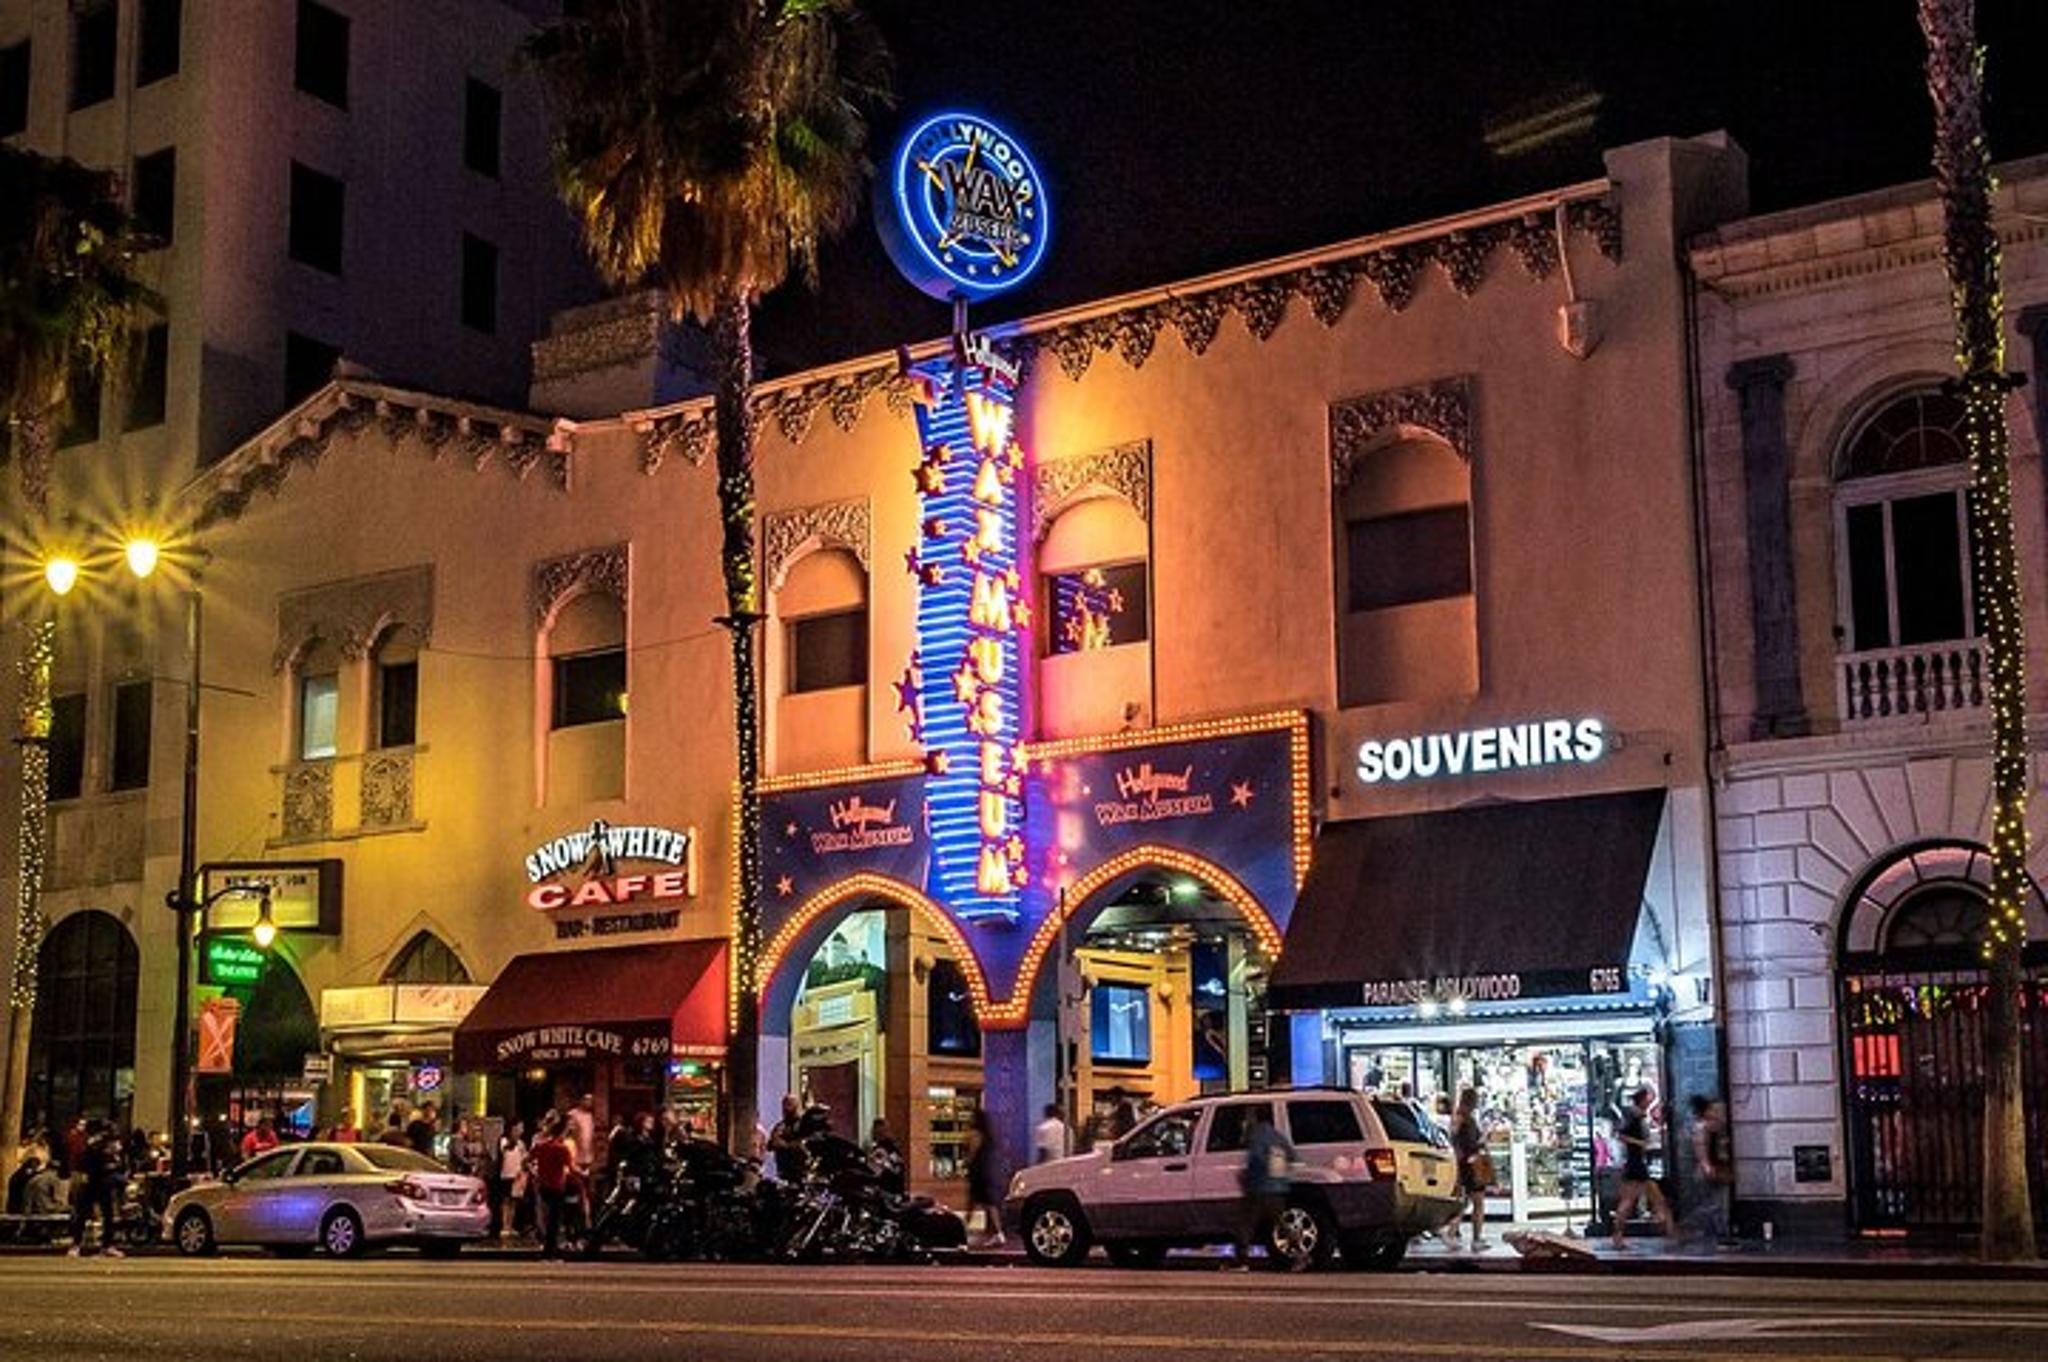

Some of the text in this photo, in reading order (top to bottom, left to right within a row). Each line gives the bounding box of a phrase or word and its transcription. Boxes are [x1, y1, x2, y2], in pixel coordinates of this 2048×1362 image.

[911, 122, 1034, 201] OLLYWOOD
[941, 158, 1021, 222] WAX
[969, 572, 1013, 894] MUSEUM
[1357, 718, 1604, 783] SOUVENIRS
[1139, 793, 1214, 822] MUSEUM
[525, 825, 688, 883] SNOW WHITE
[527, 871, 685, 910] CAFE
[592, 911, 680, 935] RESTAURANT
[1362, 967, 1621, 1005] PARADISE HOLLYWOOD 6765
[496, 1031, 537, 1062] SNOW
[539, 1026, 584, 1045] WHITE
[585, 1028, 624, 1055] CAFE
[631, 1036, 670, 1055] 6769
